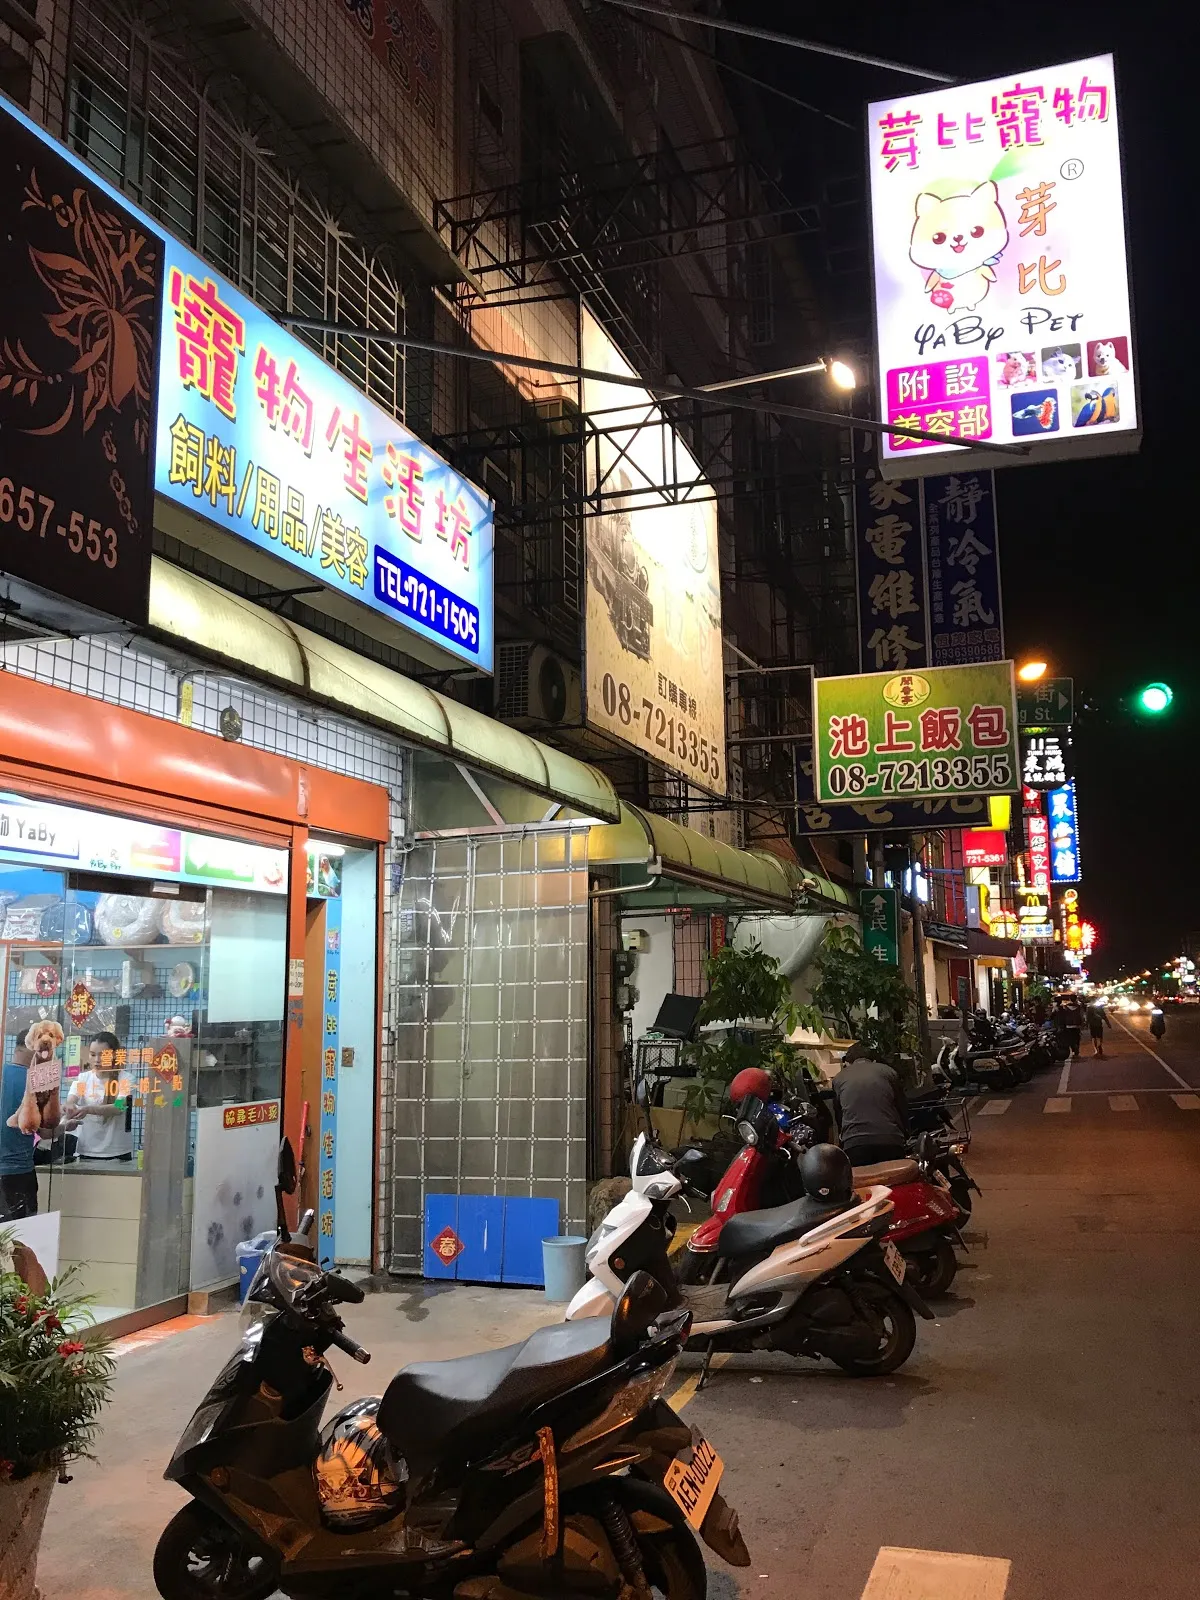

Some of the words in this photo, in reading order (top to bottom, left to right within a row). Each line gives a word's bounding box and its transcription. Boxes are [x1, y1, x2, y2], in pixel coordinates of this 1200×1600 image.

[879, 76, 1111, 172] 芽比寵物
[1015, 181, 1067, 297] 芽比
[168, 265, 475, 571] 寵物生活坊
[897, 363, 980, 404] 附設
[168, 413, 370, 590] 飼料/用品/美容
[602, 672, 720, 780] 08-7213355
[828, 704, 1009, 758] 池上飯包
[1035, 707, 1054, 721] St.
[828, 755, 1011, 796] 08-7213355
